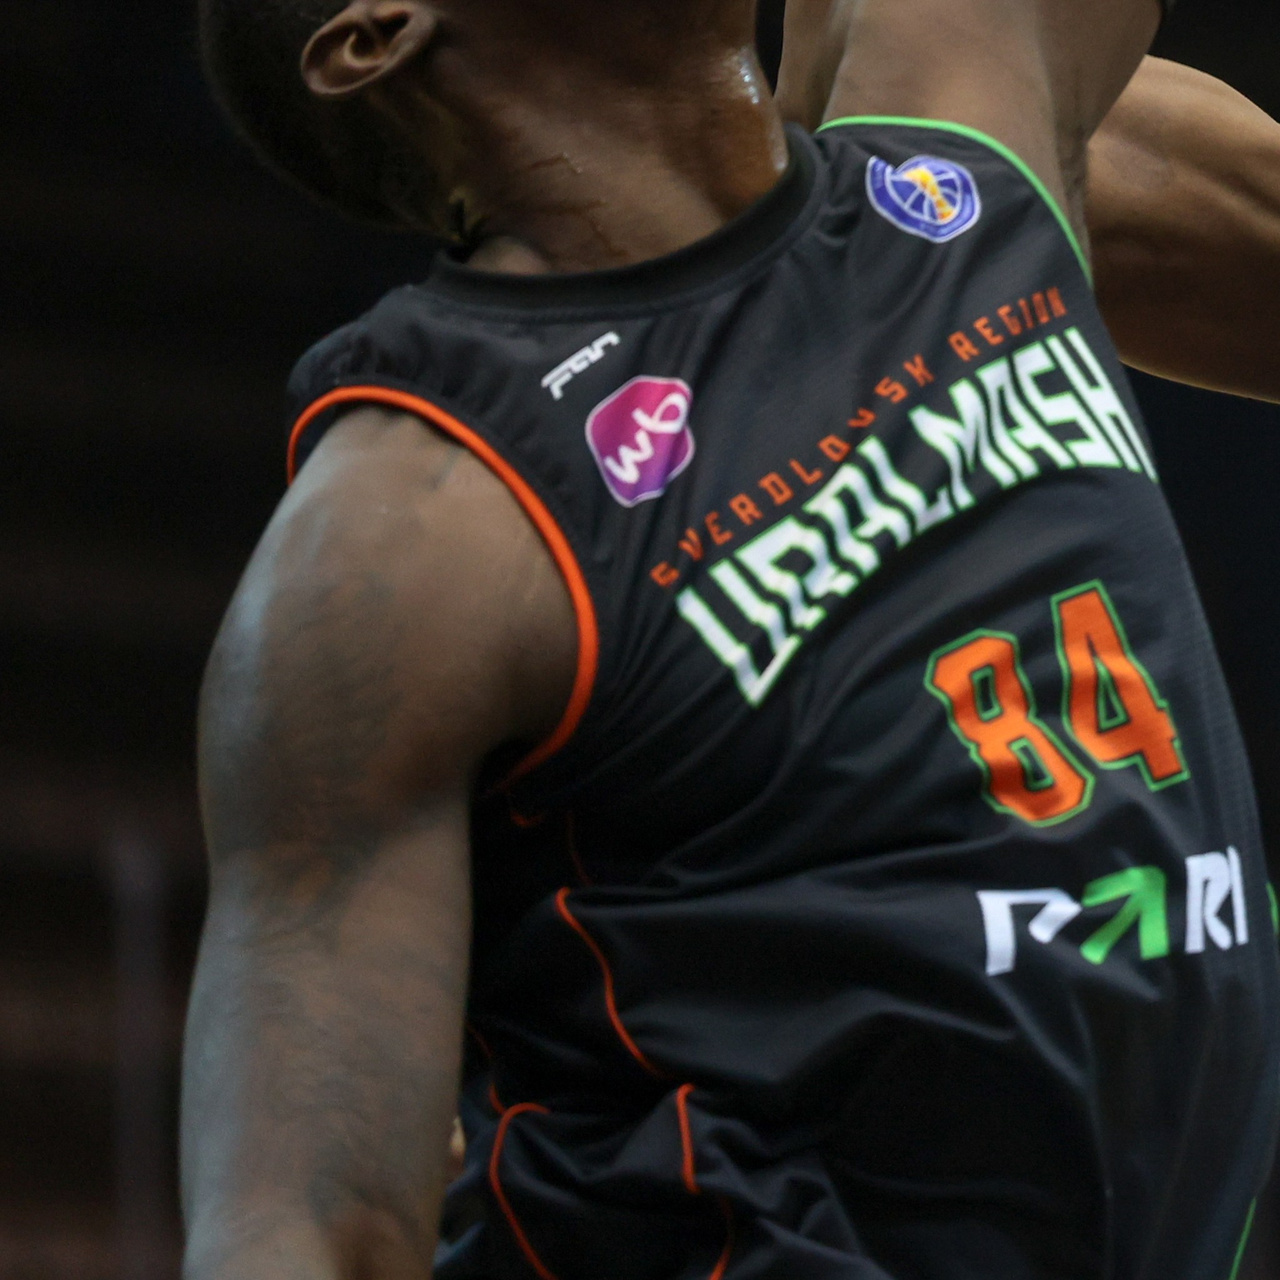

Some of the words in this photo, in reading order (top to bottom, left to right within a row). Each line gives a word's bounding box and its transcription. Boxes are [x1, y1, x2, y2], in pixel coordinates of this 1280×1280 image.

[946, 287, 1068, 362] REGION
[675, 327, 1158, 707] URALMASH
[924, 579, 1190, 827] 84
